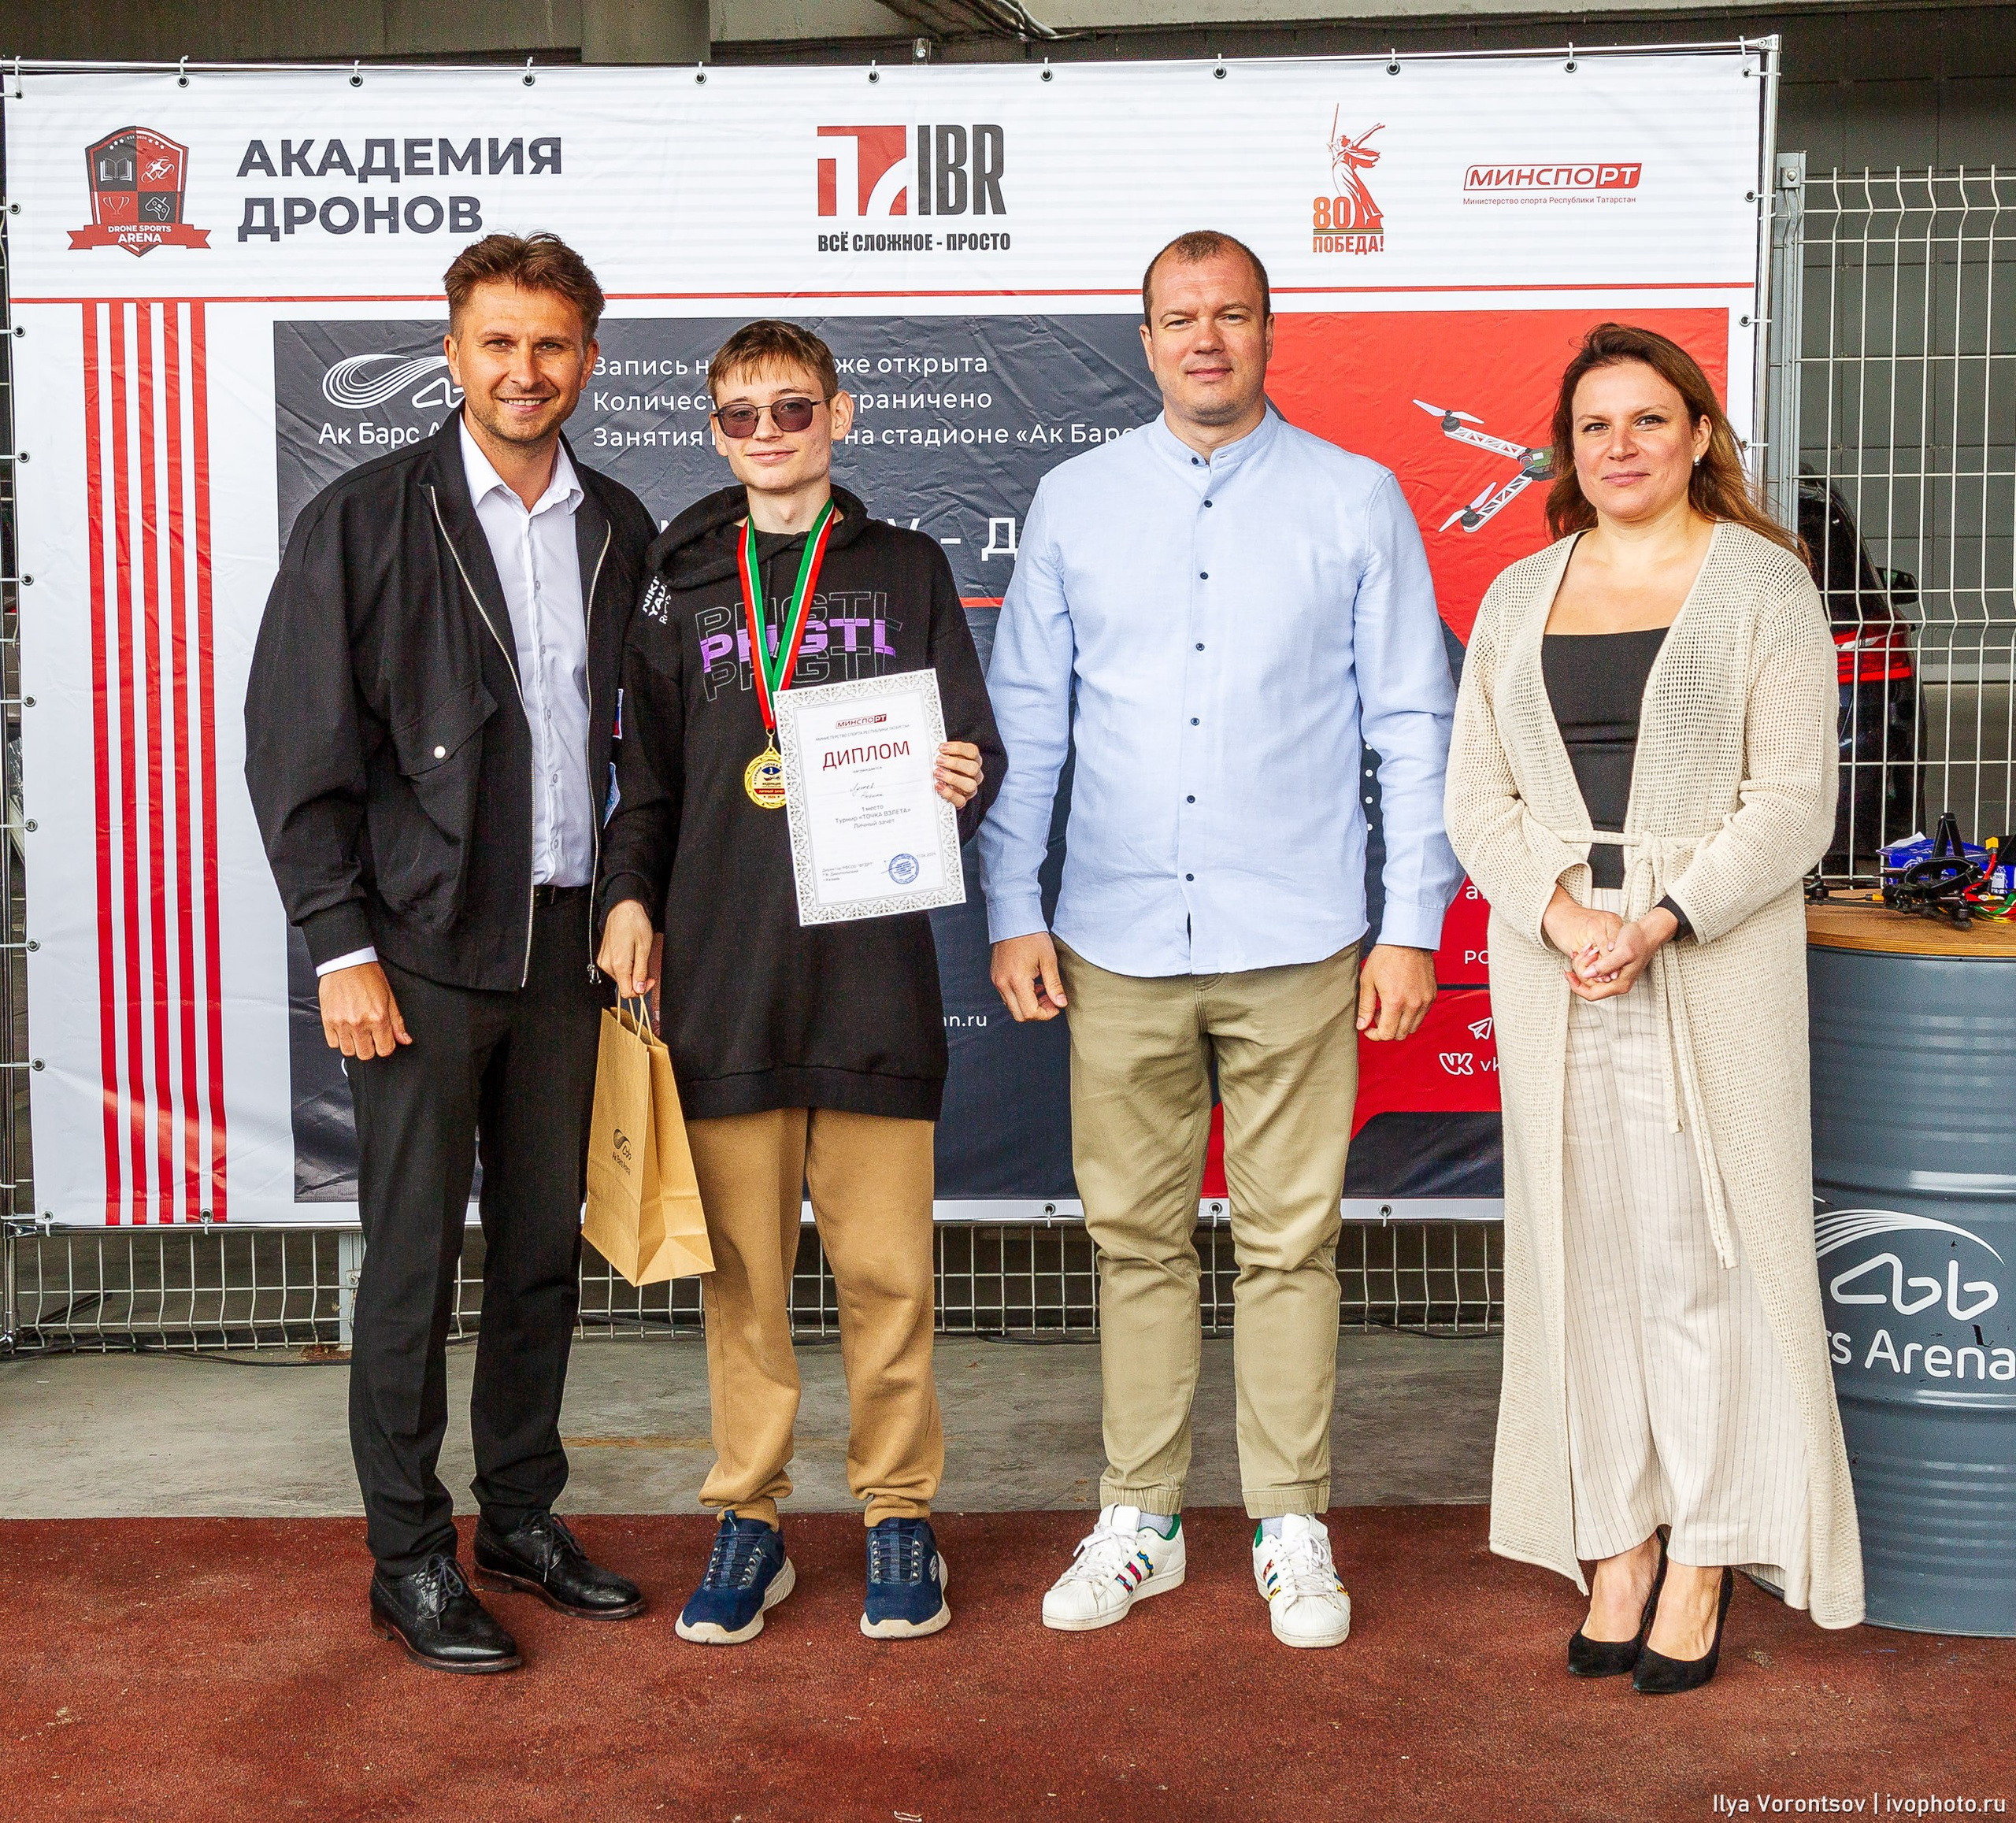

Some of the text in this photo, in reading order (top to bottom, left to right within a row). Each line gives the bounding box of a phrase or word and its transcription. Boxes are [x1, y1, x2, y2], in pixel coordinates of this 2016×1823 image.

[236, 136, 562, 183] АКАДЕМИЯ
[917, 124, 1007, 216] IBR
[1469, 165, 1640, 187] МИНСПОРТ
[1462, 195, 1636, 206] Министерство спорта Республики Татарстан
[238, 195, 483, 243] ДРОНОВ
[1313, 196, 1351, 229] 80
[107, 224, 138, 233] DRONE
[117, 233, 163, 243] ARENA
[817, 232, 849, 252] ВСЁ
[852, 233, 933, 252] СЛОЖНОЕ
[946, 232, 1011, 251] ПРОСТО
[1313, 235, 1384, 255] ПОБЕДА!
[592, 356, 688, 376] Запись
[877, 357, 988, 378] открыта
[593, 391, 717, 412] Количест
[318, 422, 352, 445] Ак
[358, 422, 421, 450] Барс
[593, 427, 703, 447] Занятия
[845, 428, 874, 445] на
[881, 428, 1009, 447] стадионе
[1016, 424, 1063, 444] «Ак
[836, 714, 887, 728] МИНСПОРТ
[822, 740, 910, 772] ДИПЛОМ
[1864, 1328, 2016, 1381] Arena
